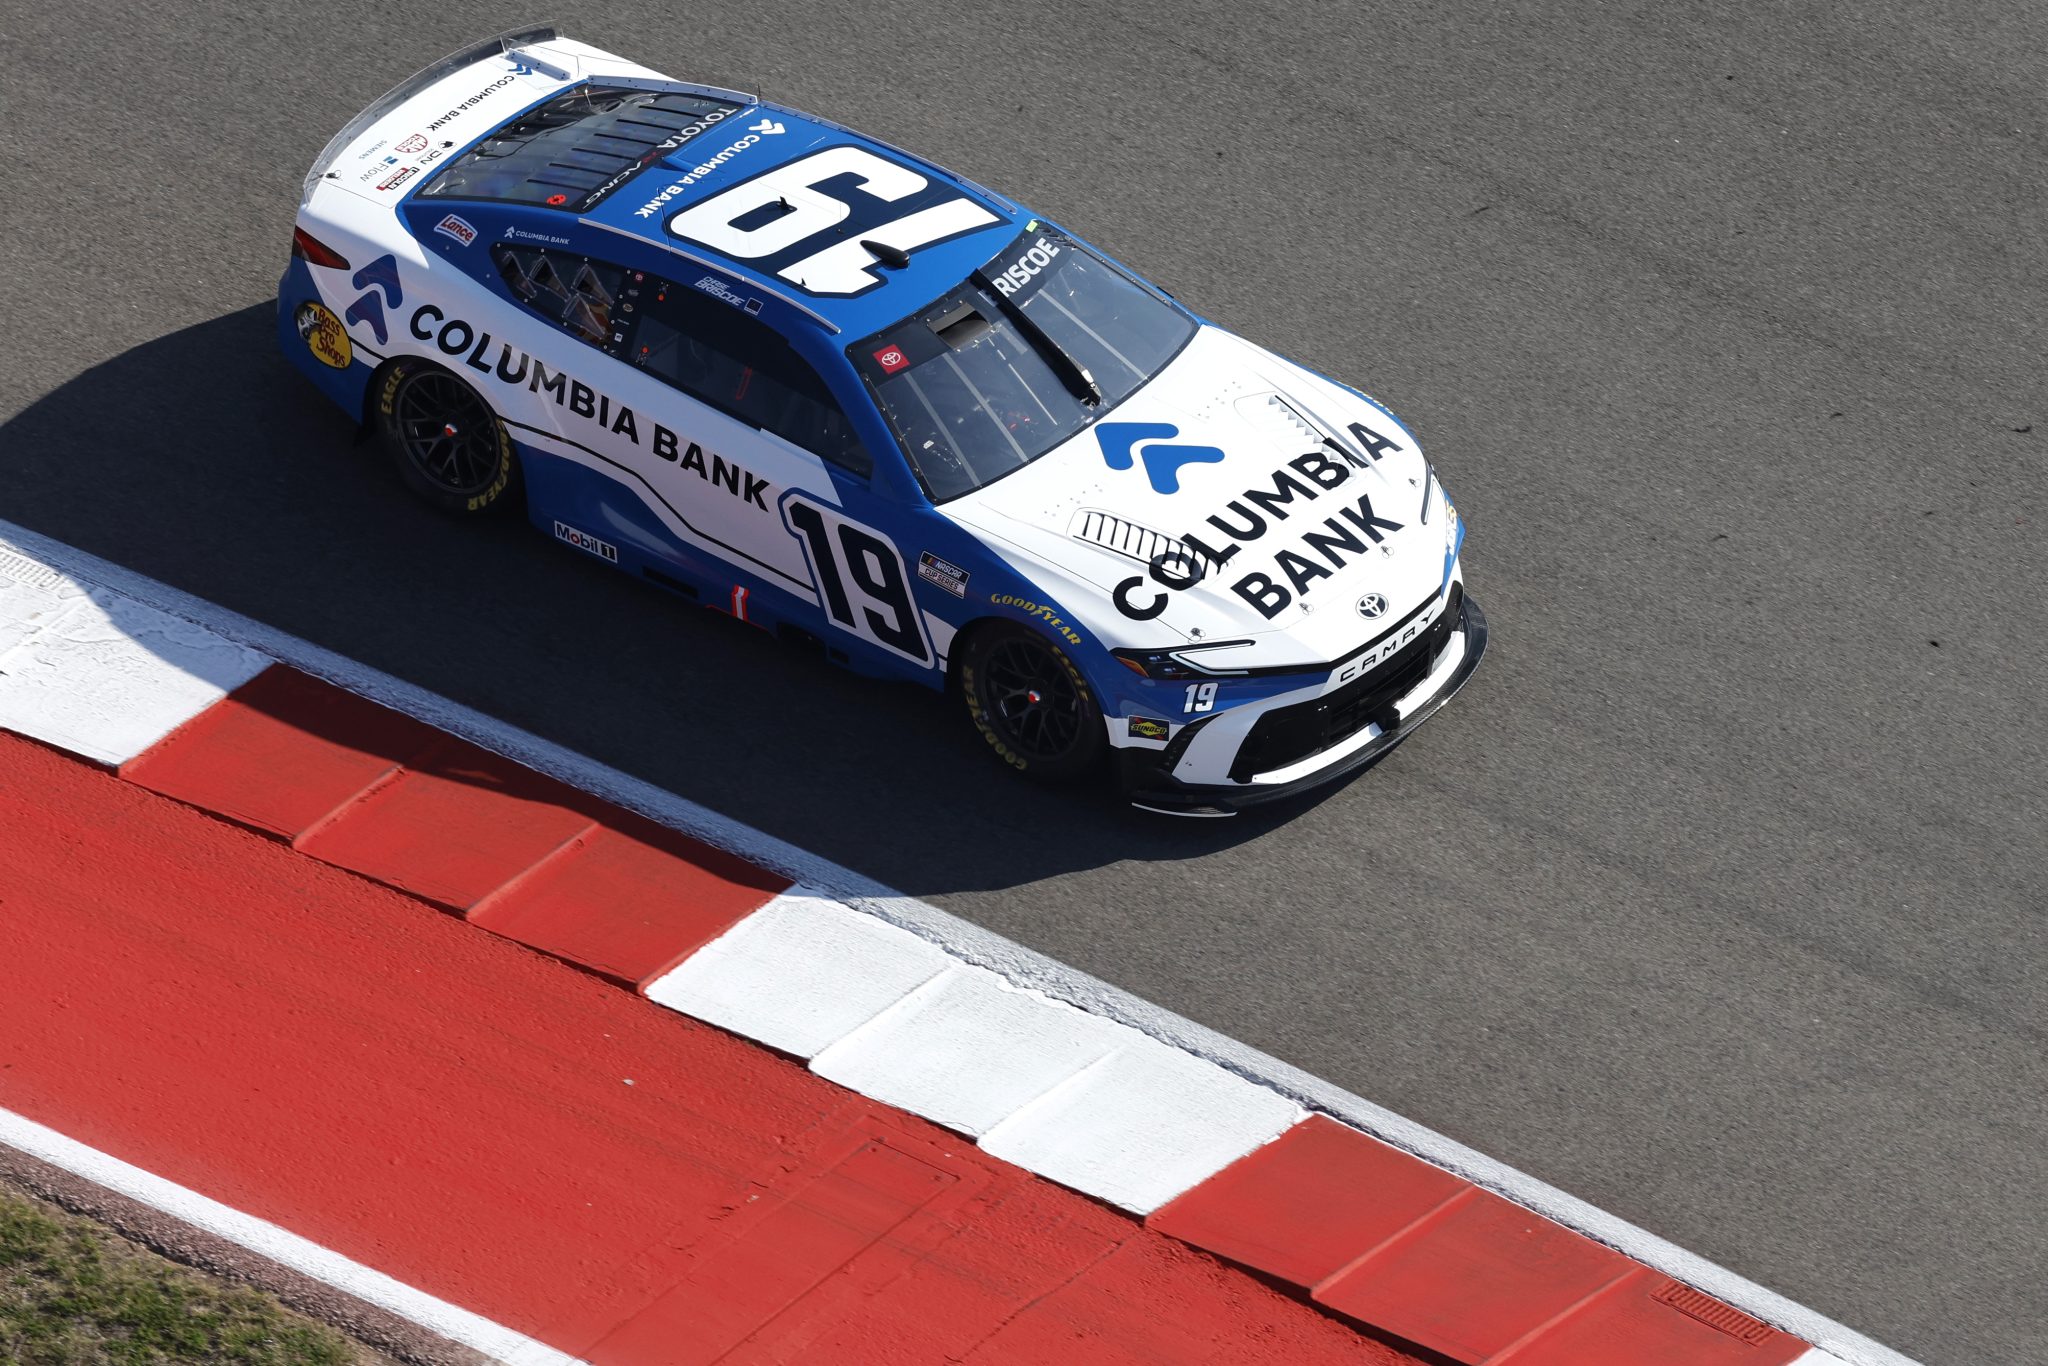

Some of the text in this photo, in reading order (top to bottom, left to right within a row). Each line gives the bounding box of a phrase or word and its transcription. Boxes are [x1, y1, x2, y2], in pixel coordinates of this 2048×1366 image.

[426, 75, 515, 132] COLUMBIA BANK
[656, 105, 737, 149] TOYOTA
[358, 140, 387, 160] SIEMENS
[360, 161, 389, 182] Flow
[387, 166, 418, 190] LINCOLN
[634, 135, 760, 218] COLUMBIA BANK
[440, 215, 474, 241] Lance
[671, 147, 1001, 293] 19
[515, 230, 570, 245] COLUMBIA BANK
[703, 276, 730, 290] CHASE
[977, 238, 1060, 307] RISCOE
[694, 279, 745, 306] BRISCOE
[319, 308, 340, 336] Bass
[319, 321, 335, 345] Pro
[316, 337, 345, 367] Shops
[410, 304, 770, 512] COLUMBIA BANK
[1112, 421, 1404, 621] COLUMBIA
[556, 523, 599, 554] Mobil
[935, 560, 963, 580] NASCAR
[1230, 493, 1406, 620] BANK
[788, 501, 929, 663] 19
[925, 568, 959, 590] CUP SERIES
[990, 592, 1082, 646] GOODYEAR
[1340, 608, 1435, 683] CAMRY
[1183, 683, 1219, 713] 19
[1131, 724, 1167, 735] SUNOCO
